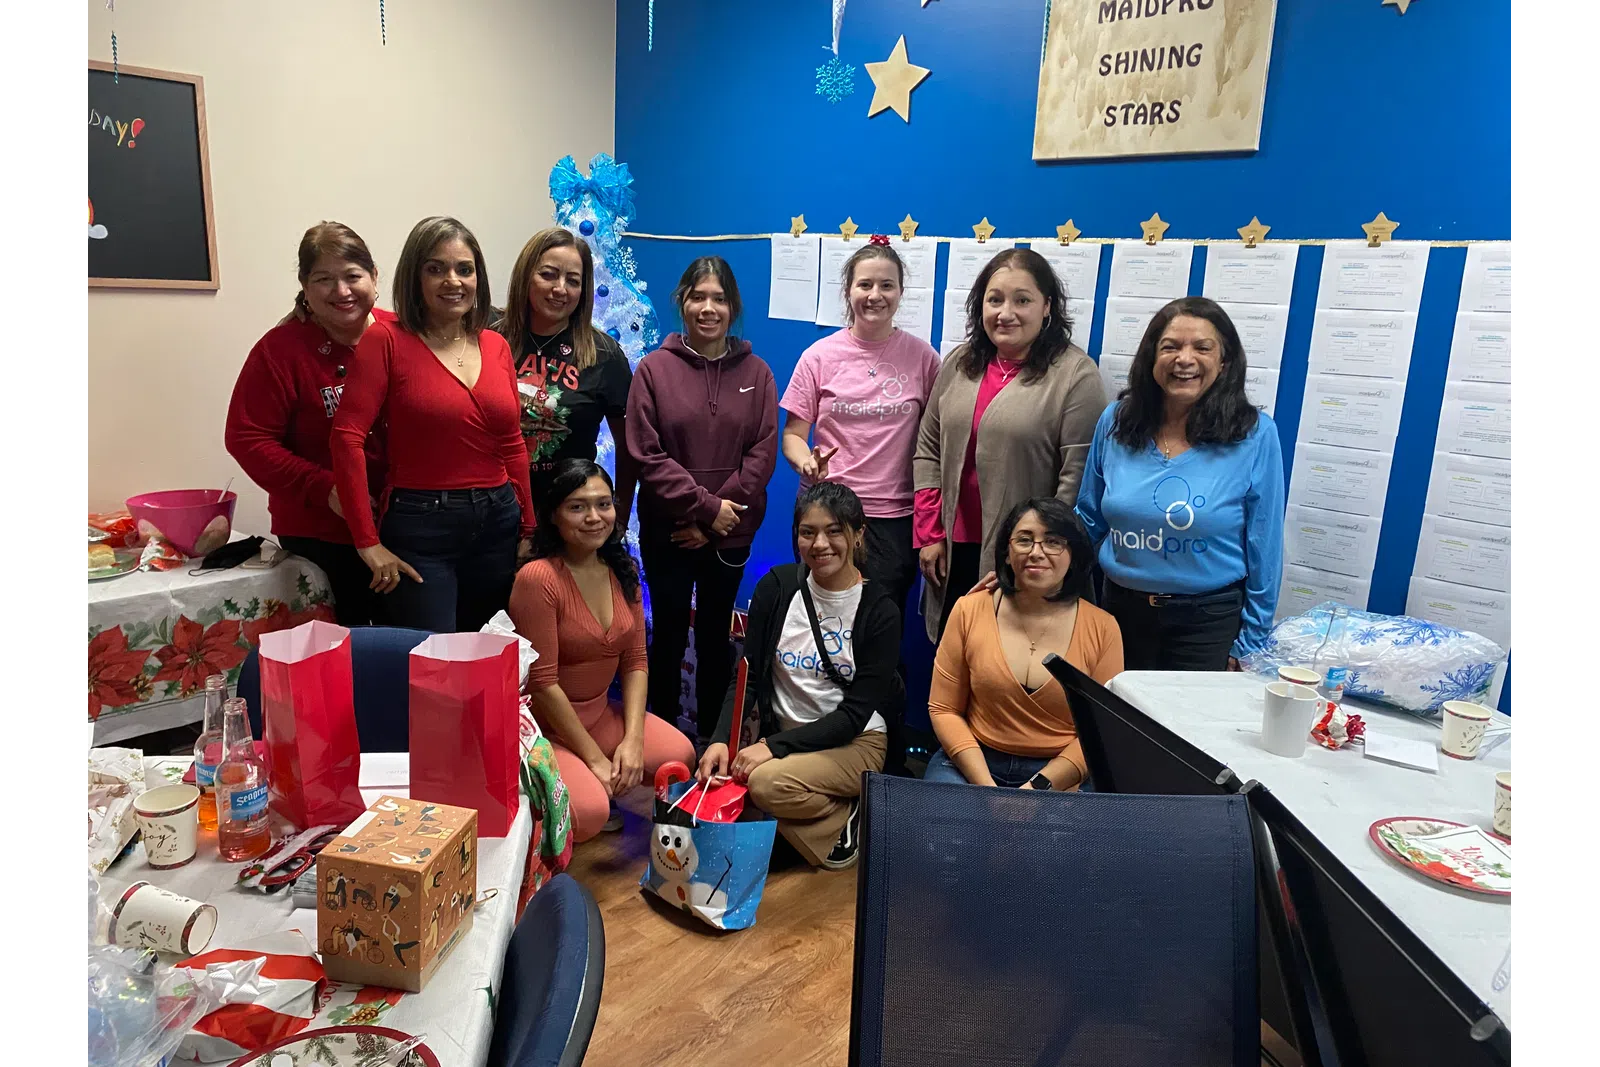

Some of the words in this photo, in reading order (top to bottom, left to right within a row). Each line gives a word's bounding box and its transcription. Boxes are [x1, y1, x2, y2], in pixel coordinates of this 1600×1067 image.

[1098, 43, 1203, 76] SHINING
[1103, 99, 1182, 127] STARS
[831, 397, 912, 420] maidpro
[143, 830, 172, 848] joy
